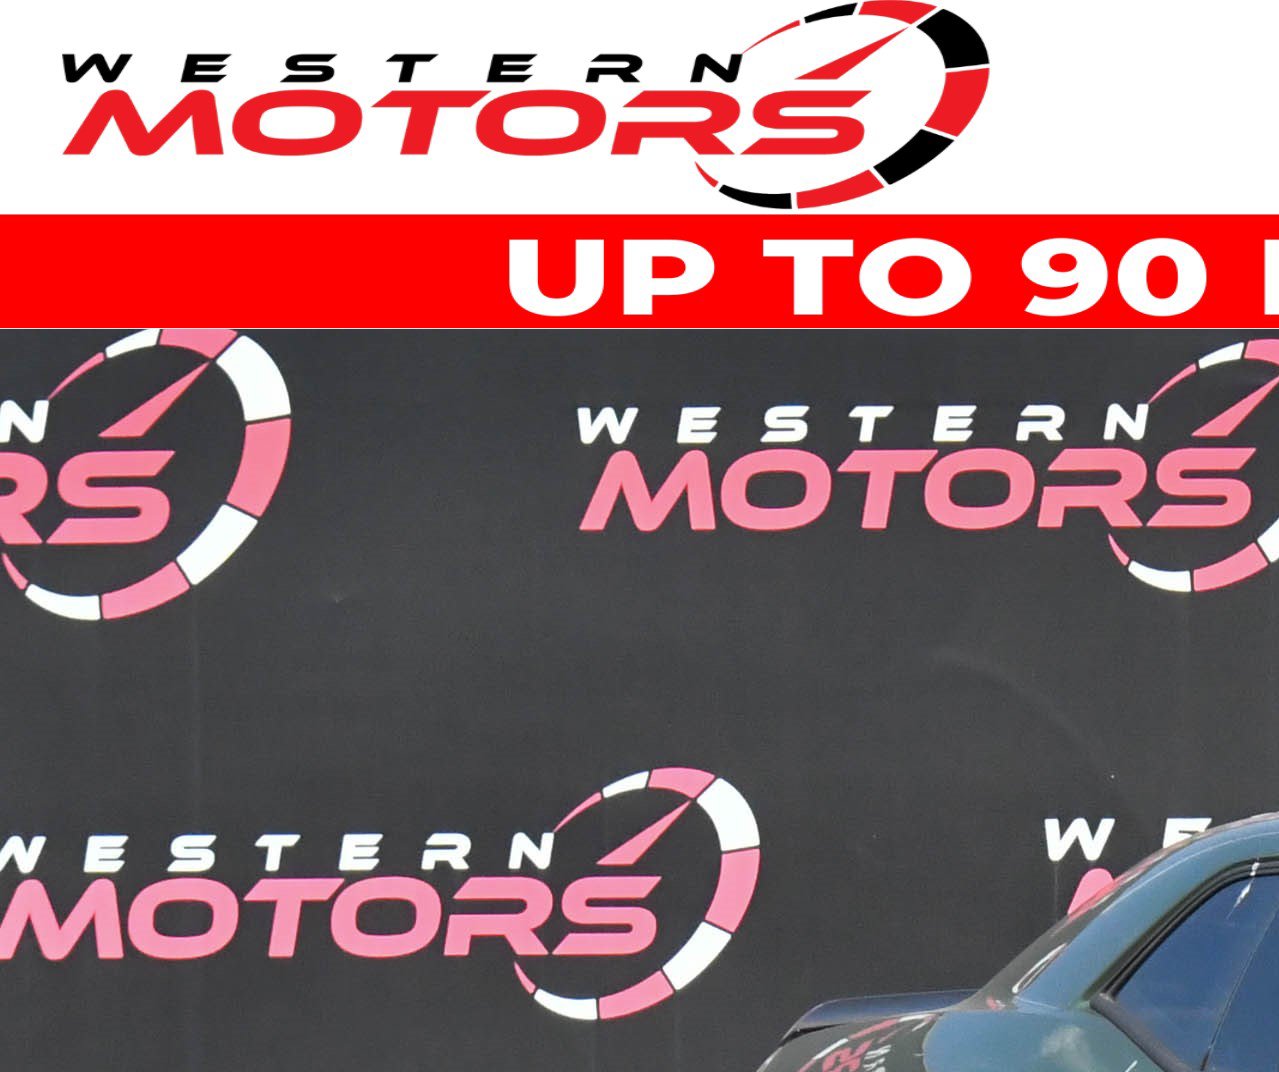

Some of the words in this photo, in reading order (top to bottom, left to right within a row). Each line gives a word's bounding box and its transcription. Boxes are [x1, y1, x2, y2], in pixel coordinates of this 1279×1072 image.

[577, 403, 1149, 445] WESTERN
[579, 447, 1257, 533] MOTORS
[0, 875, 662, 961] MOTORS
